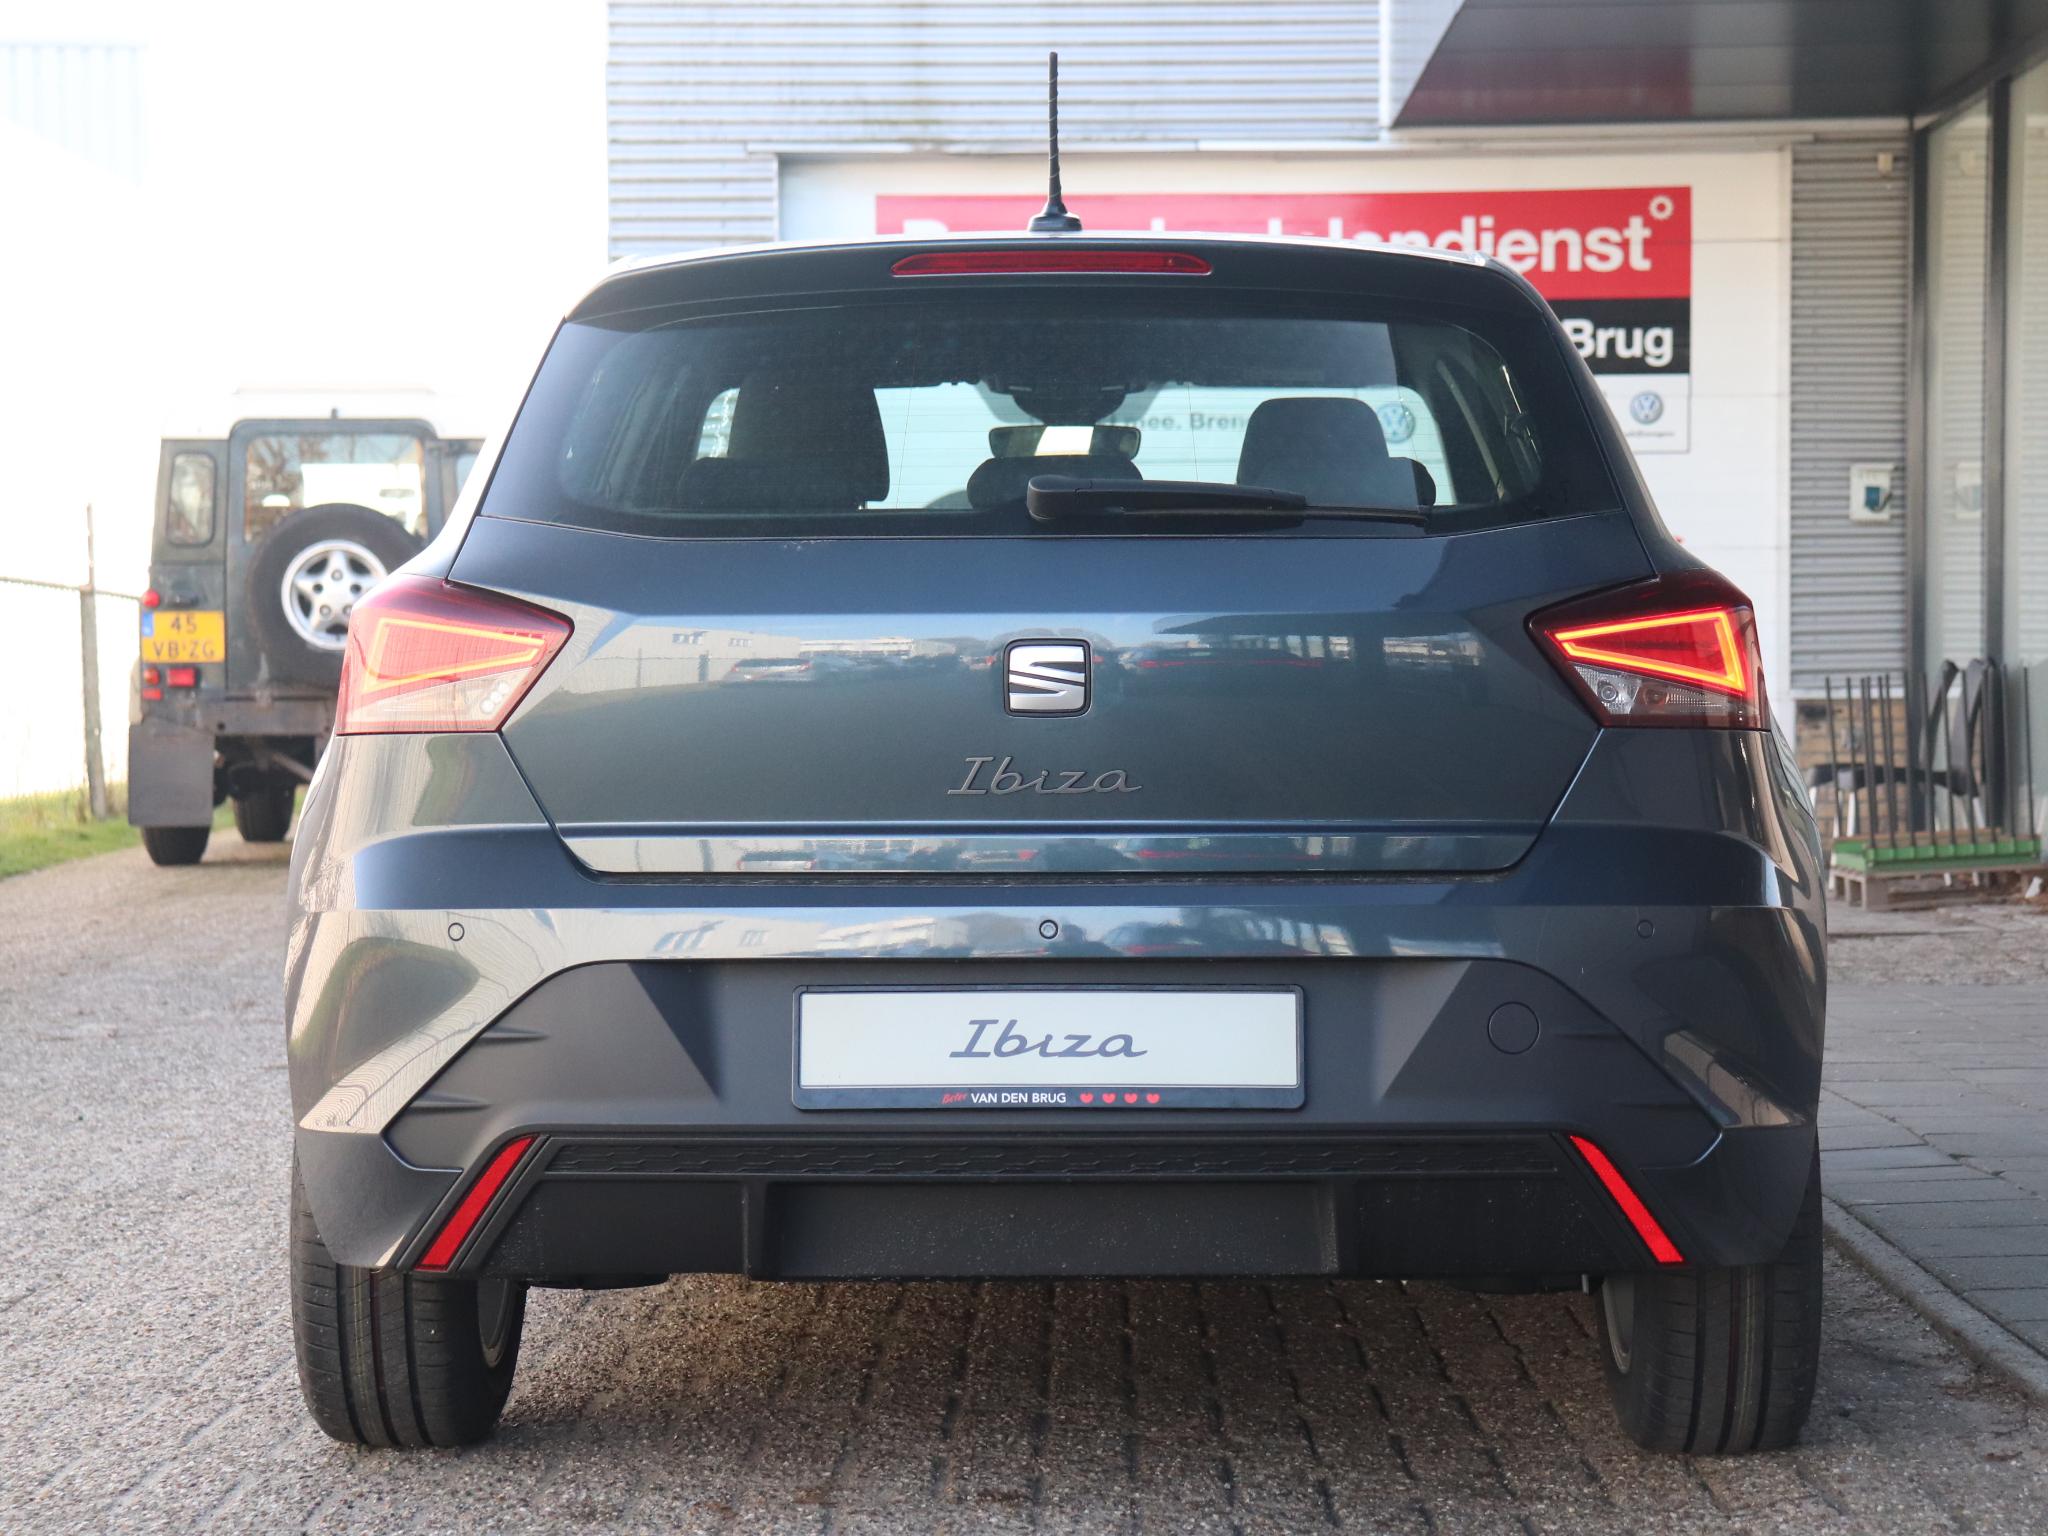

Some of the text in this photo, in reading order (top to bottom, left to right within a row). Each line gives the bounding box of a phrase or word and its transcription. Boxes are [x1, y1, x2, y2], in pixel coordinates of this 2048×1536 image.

[1561, 318, 1674, 368] Brug
[170, 613, 197, 634] 45
[947, 756, 1142, 795] Ibiza
[949, 1018, 1148, 1058] Ibiza
[971, 1092, 997, 1104] VAN
[1001, 1092, 1028, 1104] DEN
[1032, 1092, 1067, 1104] BRUG
